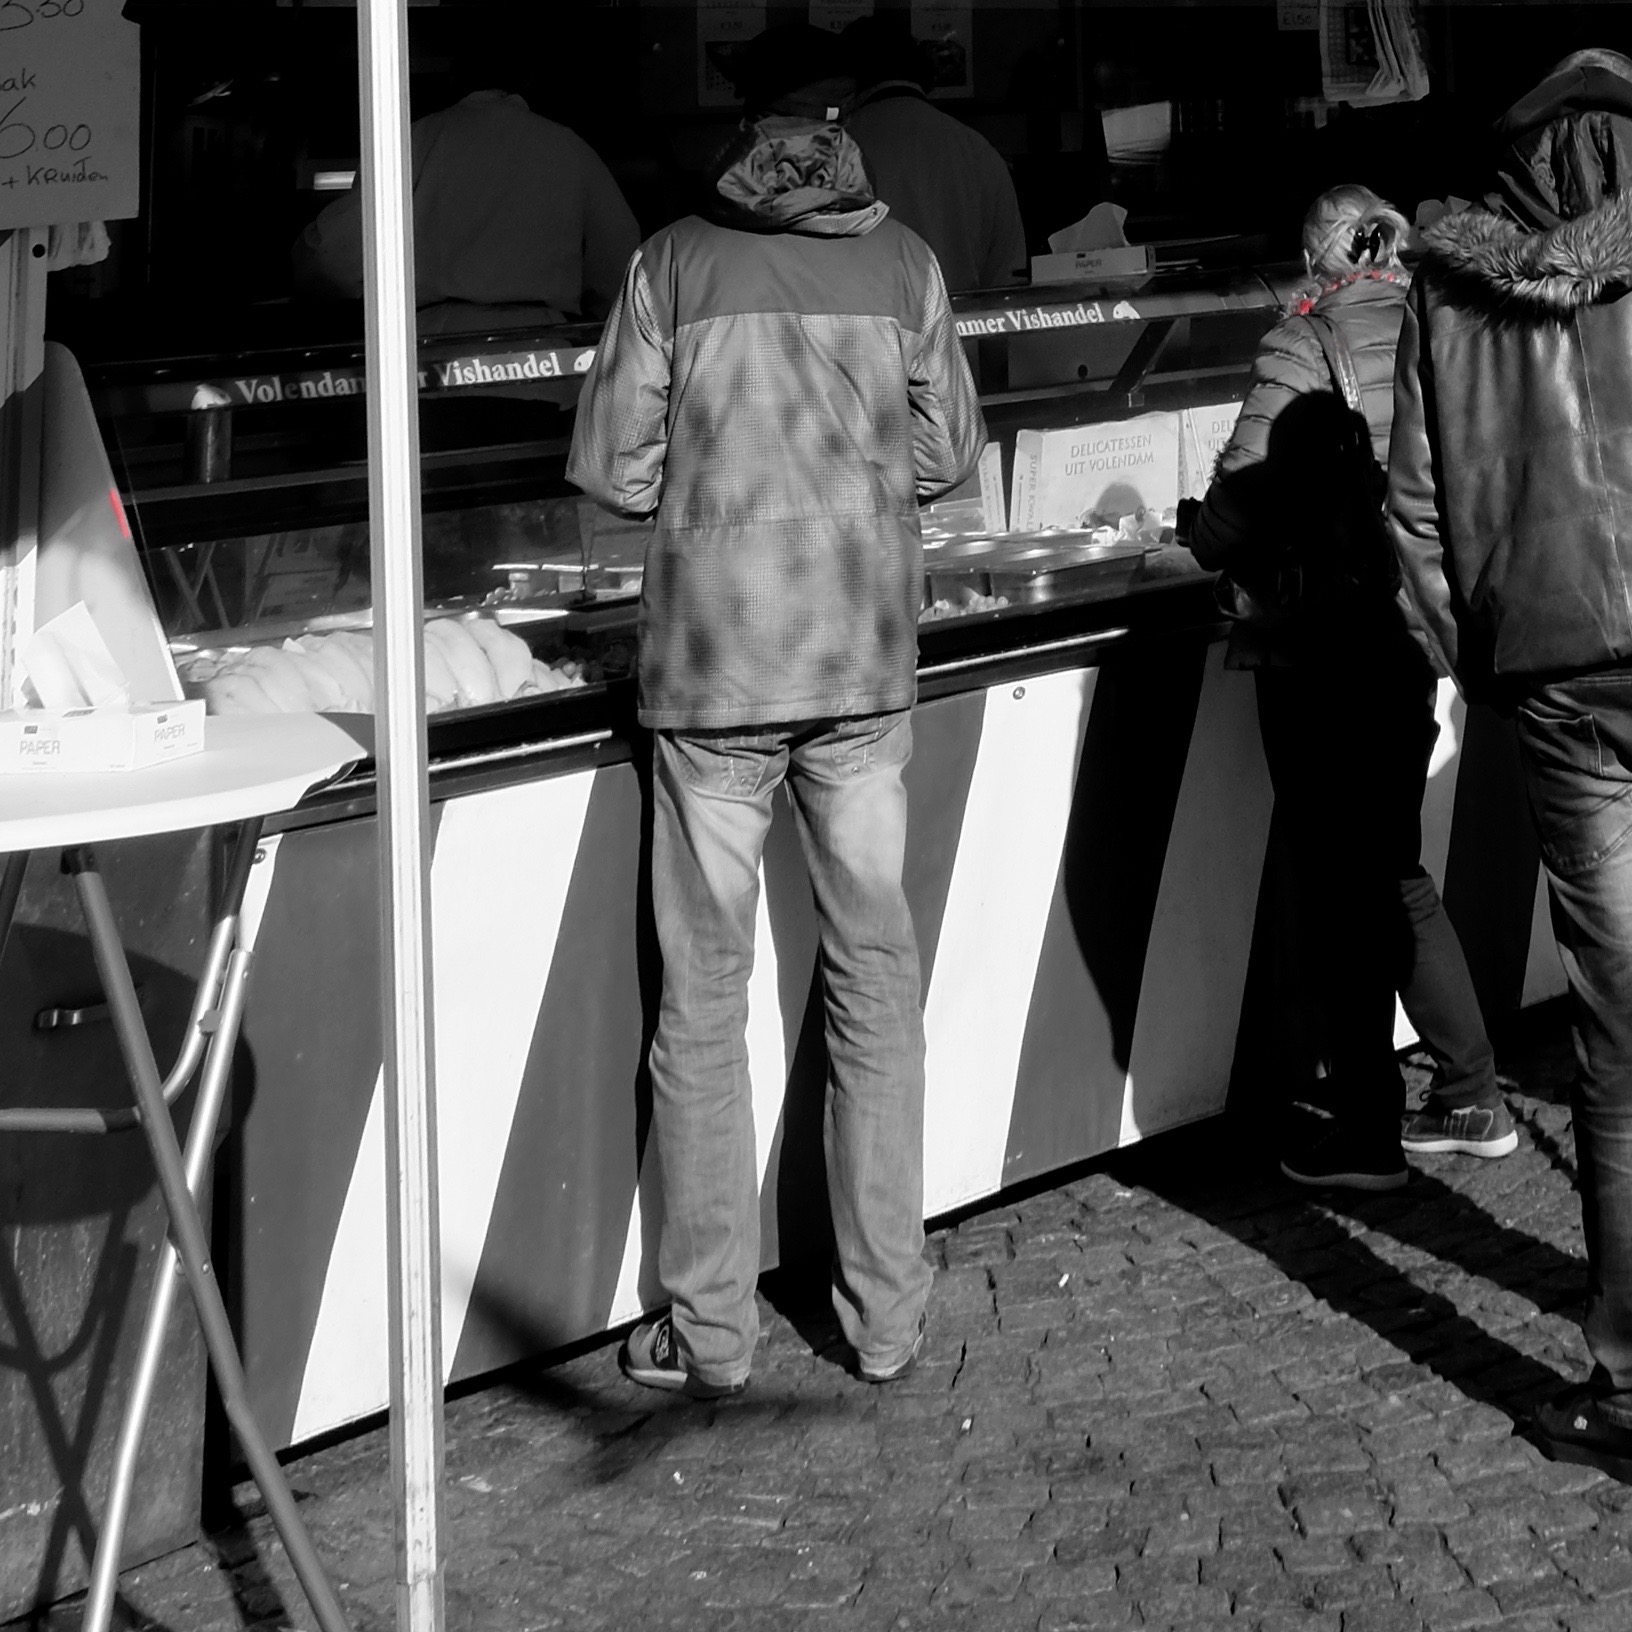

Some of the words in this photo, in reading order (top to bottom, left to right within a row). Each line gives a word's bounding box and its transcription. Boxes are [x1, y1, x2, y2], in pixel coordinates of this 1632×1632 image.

[1006, 301, 1104, 332] Vishandel
[432, 352, 563, 388] Vishandel
[1070, 435, 1153, 459] DELICATESSEN
[1028, 453, 1038, 491] SUPER
[1064, 462, 1087, 476] UIT
[1089, 453, 1155, 475] VOLENDAM
[153, 723, 186, 742] PAPER
[19, 739, 61, 756] PAPER
